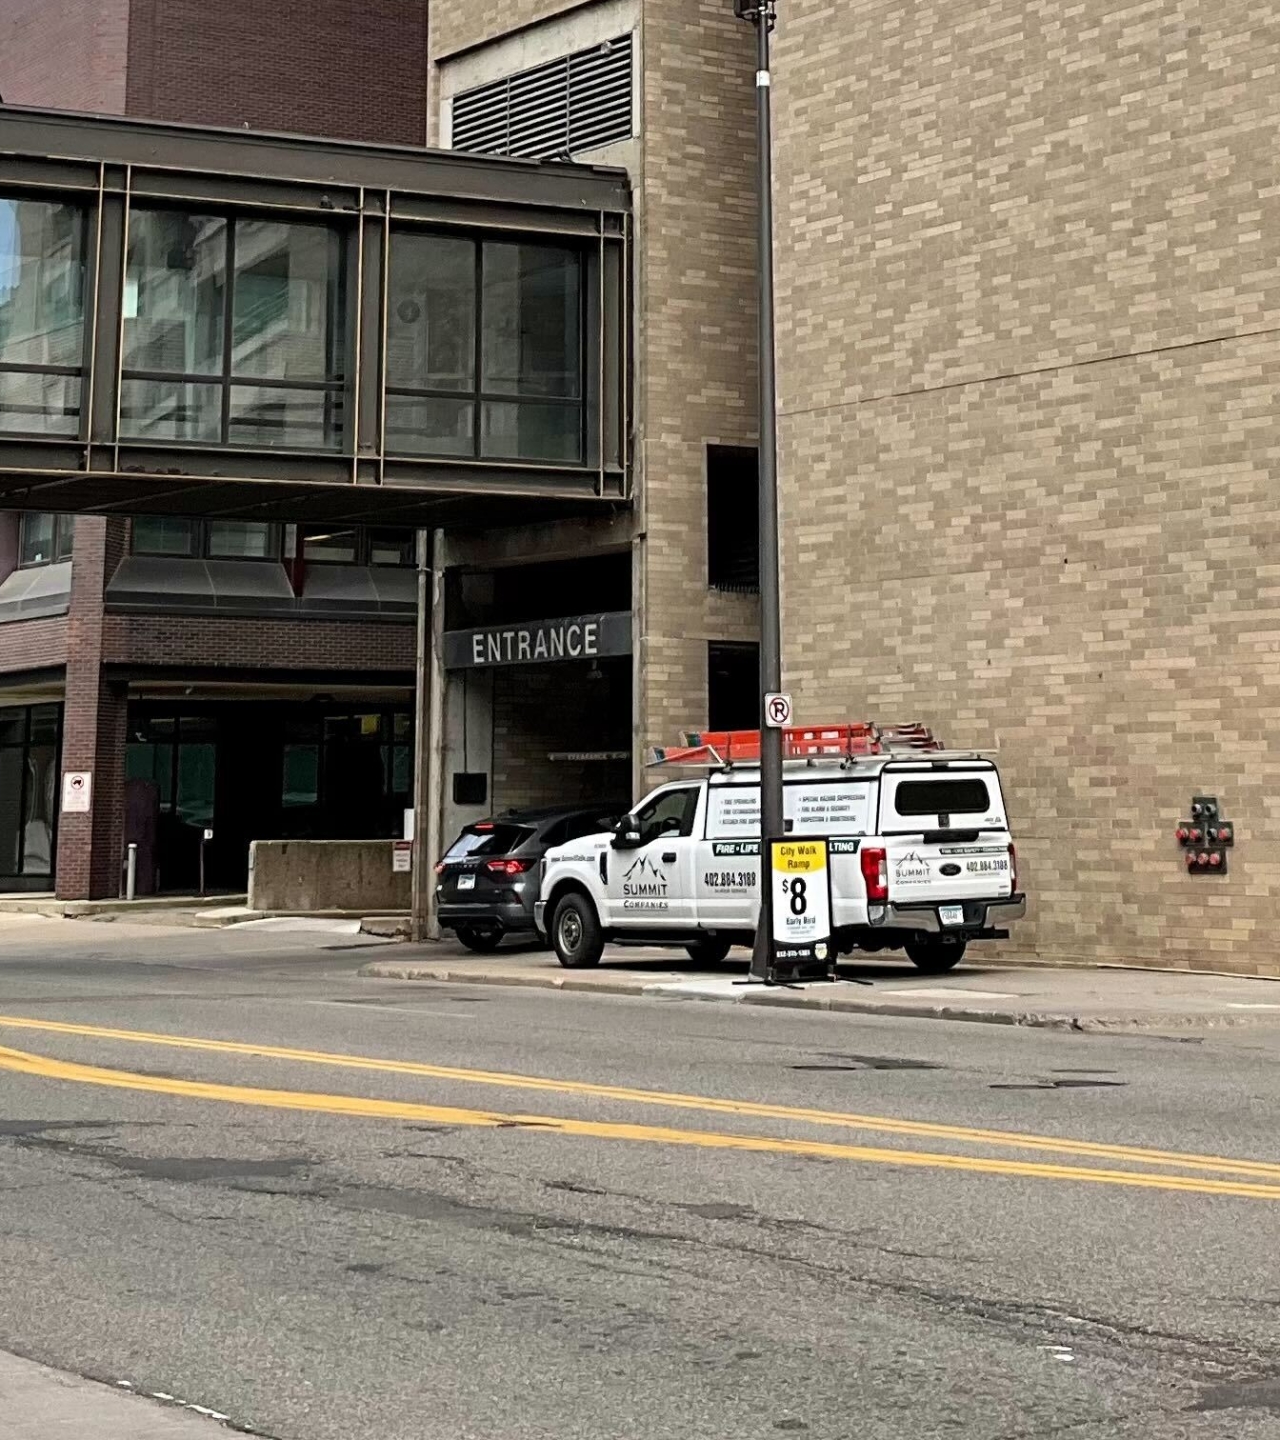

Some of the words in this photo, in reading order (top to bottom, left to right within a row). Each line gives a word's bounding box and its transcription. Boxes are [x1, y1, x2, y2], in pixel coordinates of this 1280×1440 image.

[472, 623, 598, 664] ENTRANCE
[715, 843, 735, 854] FIRE
[740, 842, 758, 853] LIFE
[780, 846, 795, 857] City
[797, 845, 817, 855] Walk
[829, 842, 854, 852] LTING
[787, 859, 810, 870] Ramp
[895, 868, 931, 878] SUMMIT
[623, 883, 668, 896] SUMMIT
[786, 916, 801, 926] Early
[803, 915, 816, 925] Bird
